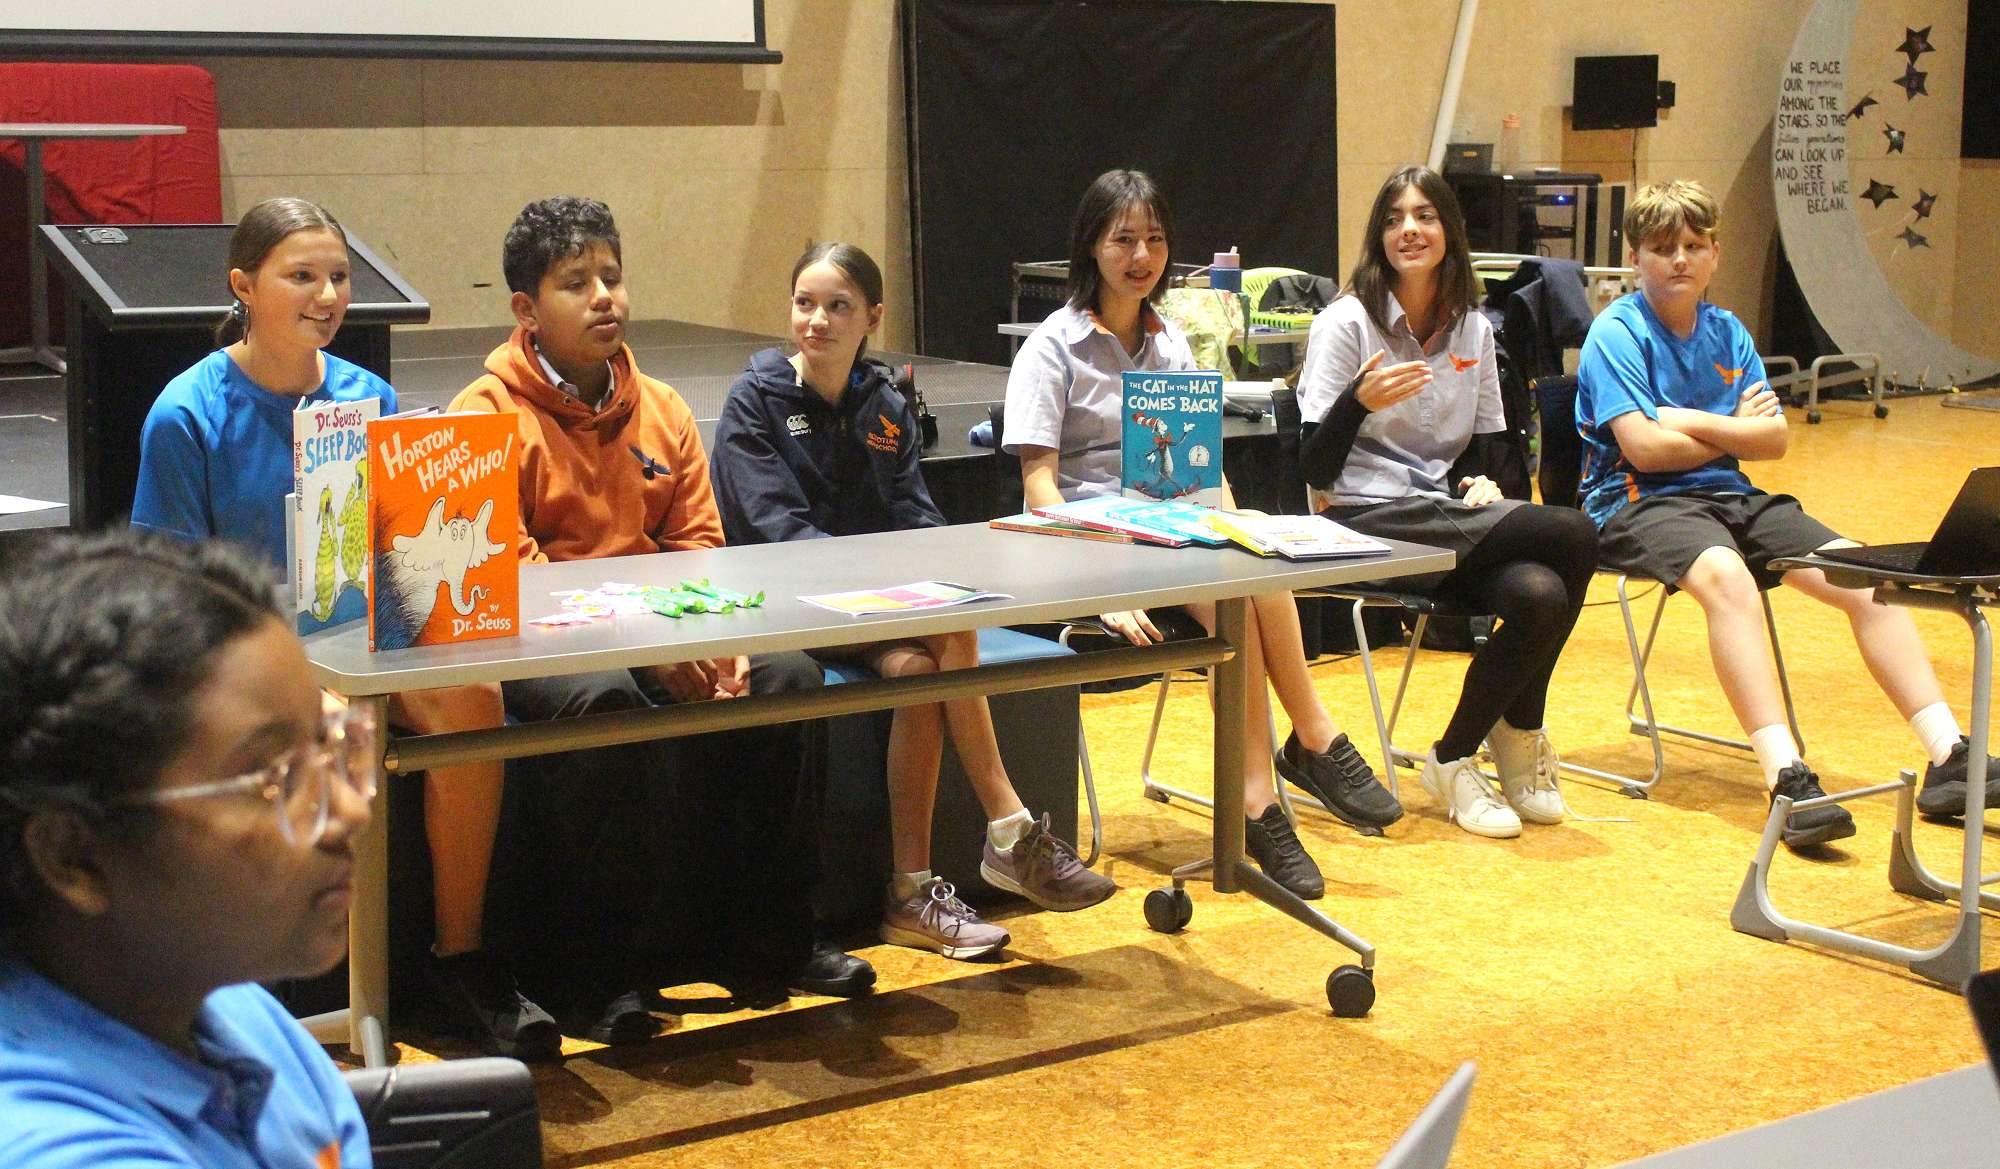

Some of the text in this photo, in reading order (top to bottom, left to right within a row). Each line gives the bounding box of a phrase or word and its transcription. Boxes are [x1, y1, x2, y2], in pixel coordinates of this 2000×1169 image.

[1790, 61, 1840, 74] WE PLACE
[1784, 78, 1803, 92] OUR
[1780, 95, 1838, 111] AMONG THE
[1816, 114, 1828, 127] SO
[1831, 114, 1847, 127] THE
[1775, 148, 1844, 162] CAN LOOK UP
[1775, 164, 1823, 180] AND SEE
[1787, 181, 1849, 197] WHERE WE
[1129, 381, 1141, 390] THE
[1142, 379, 1168, 394] CAT
[1176, 384, 1188, 392] THE
[1189, 379, 1218, 394] HAT
[1128, 395, 1218, 414] COMES BACK
[315, 406, 362, 433] Dr. Seuss's
[304, 430, 344, 474] SLEEP
[344, 429, 368, 461] BOO
[379, 427, 455, 481] HORTON
[416, 440, 471, 493] HEARS
[448, 433, 514, 493] A WHO!
[451, 612, 512, 637] Dr. Seuss
